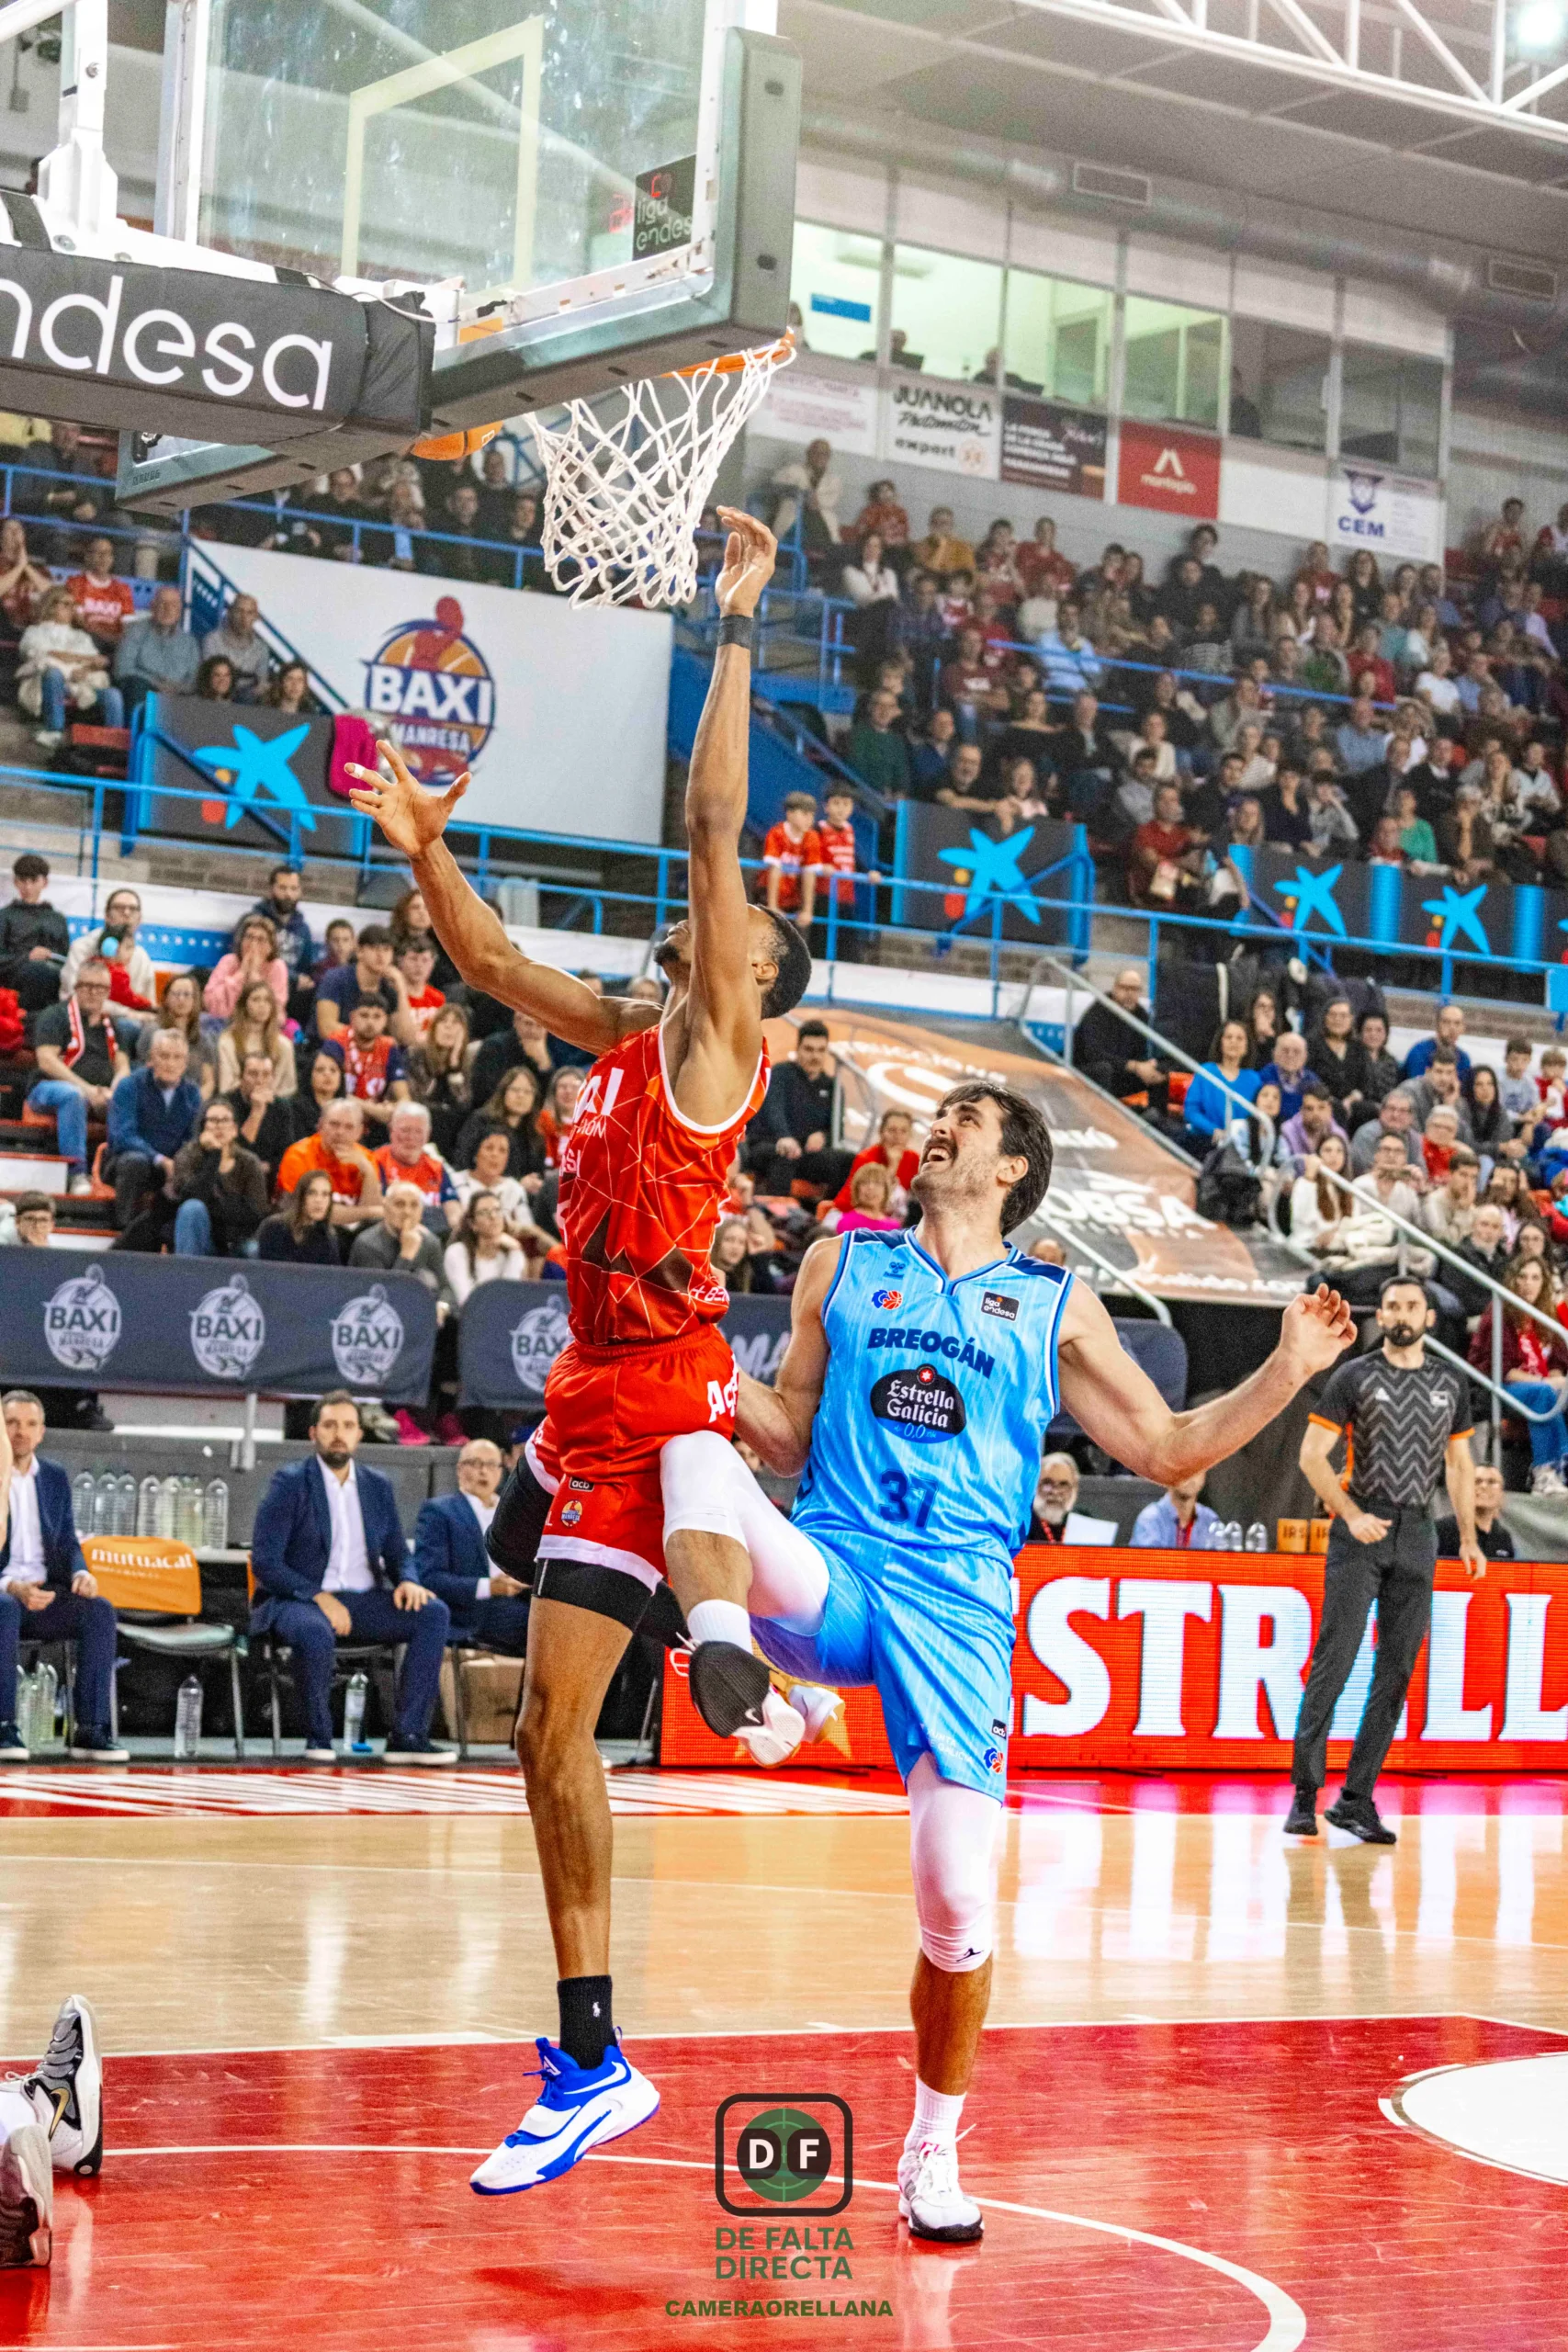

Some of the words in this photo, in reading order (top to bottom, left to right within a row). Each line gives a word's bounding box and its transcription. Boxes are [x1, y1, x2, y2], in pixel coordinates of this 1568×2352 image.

[637, 196, 669, 226] liga
[893, 385, 992, 422] JUANOLA
[1337, 516, 1384, 537] CEM
[371, 664, 491, 726] BAXI
[983, 1305, 1015, 1319] endesa
[985, 1297, 1001, 1308] liga
[50, 1307, 118, 1332] BAXI
[196, 1315, 261, 1340] BAXI
[337, 1324, 400, 1348] BAXI
[516, 1334, 567, 1357] BAX
[867, 1328, 996, 1378] BREOGÁN
[887, 1379, 954, 1410] Estrella
[886, 1397, 949, 1429] Galicia
[571, 1479, 590, 1489] acb
[879, 1468, 939, 1530] 37
